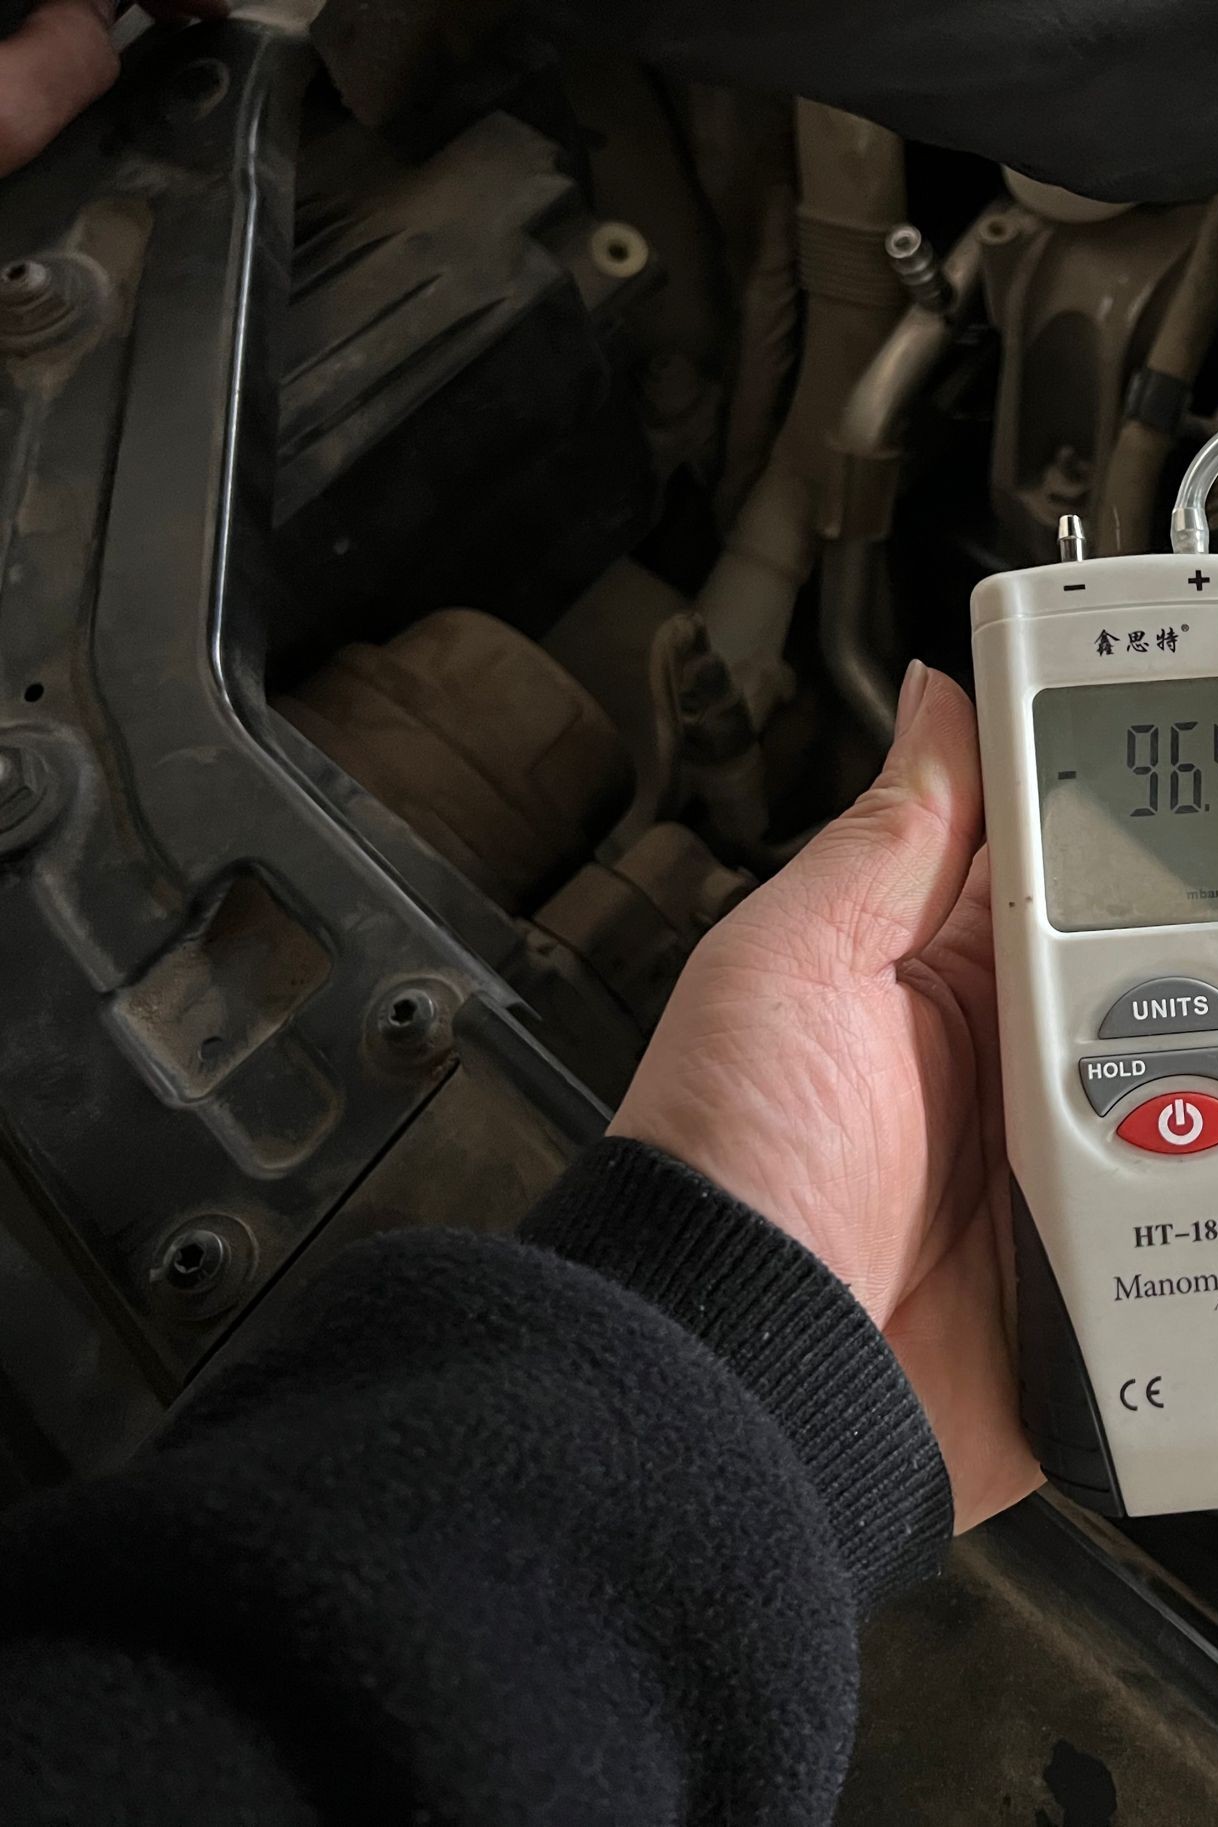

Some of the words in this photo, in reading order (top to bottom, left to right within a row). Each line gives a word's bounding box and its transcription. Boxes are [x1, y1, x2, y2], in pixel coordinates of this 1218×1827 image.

[1132, 995, 1209, 1021] UNITS
[1087, 1059, 1146, 1080] HOLD
[1118, 1375, 1165, 1412] CE
